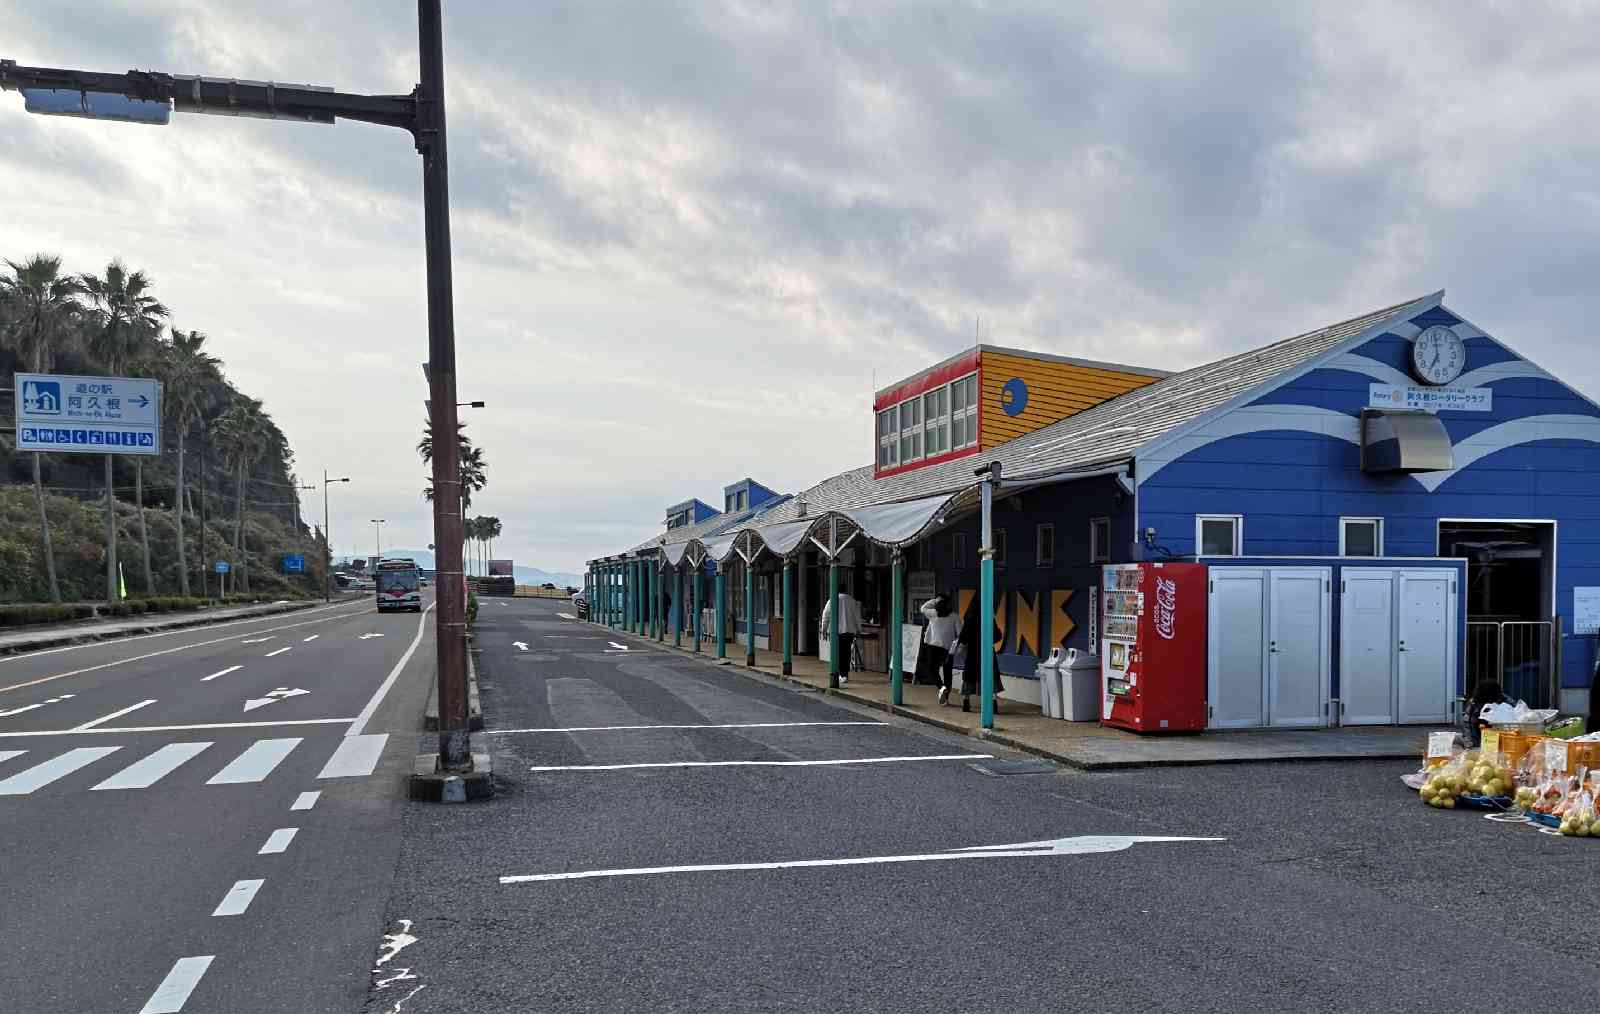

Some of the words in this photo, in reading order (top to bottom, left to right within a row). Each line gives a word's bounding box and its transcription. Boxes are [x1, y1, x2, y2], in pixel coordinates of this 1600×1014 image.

[75, 383, 113, 394] 道の駅
[68, 396, 121, 410] 阿久根
